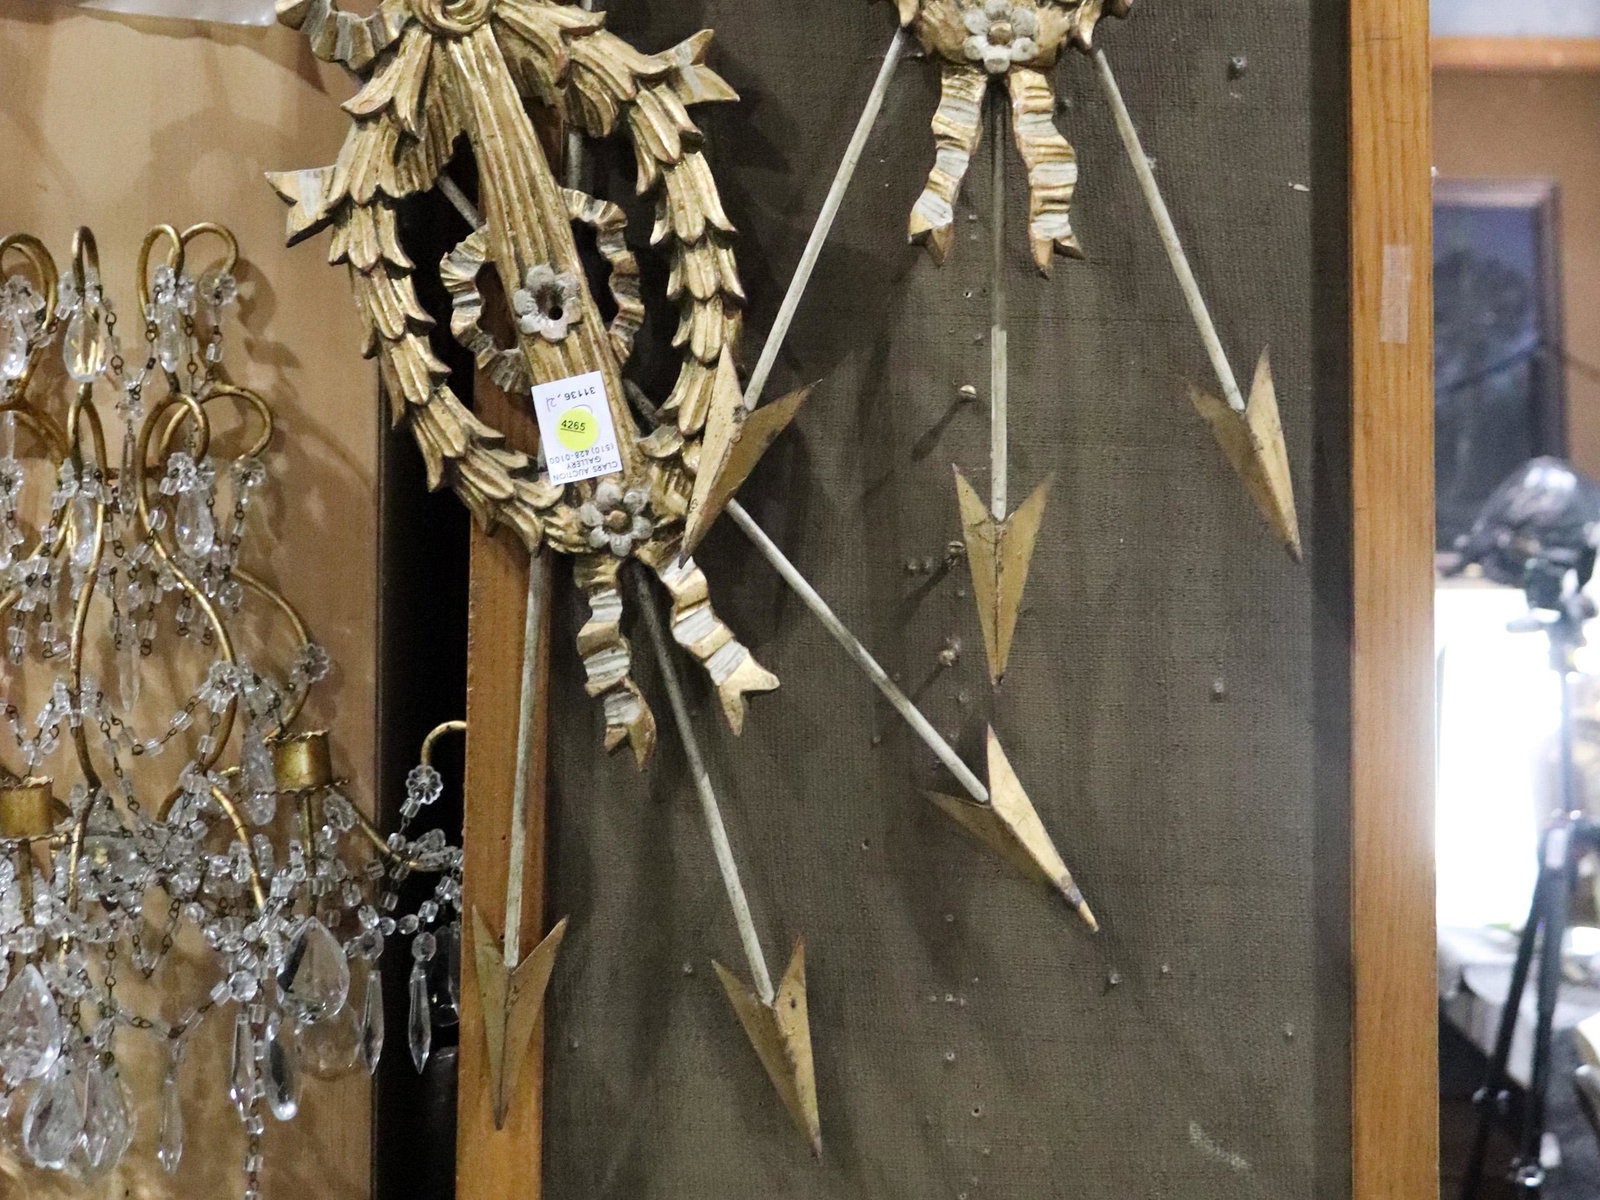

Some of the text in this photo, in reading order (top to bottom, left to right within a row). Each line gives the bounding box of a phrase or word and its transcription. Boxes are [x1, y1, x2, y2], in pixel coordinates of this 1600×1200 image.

[564, 386, 597, 400] 31136
[560, 419, 586, 431] 4265
[566, 455, 602, 469] GALLERY
[552, 460, 619, 481] CLARS AUCTION
